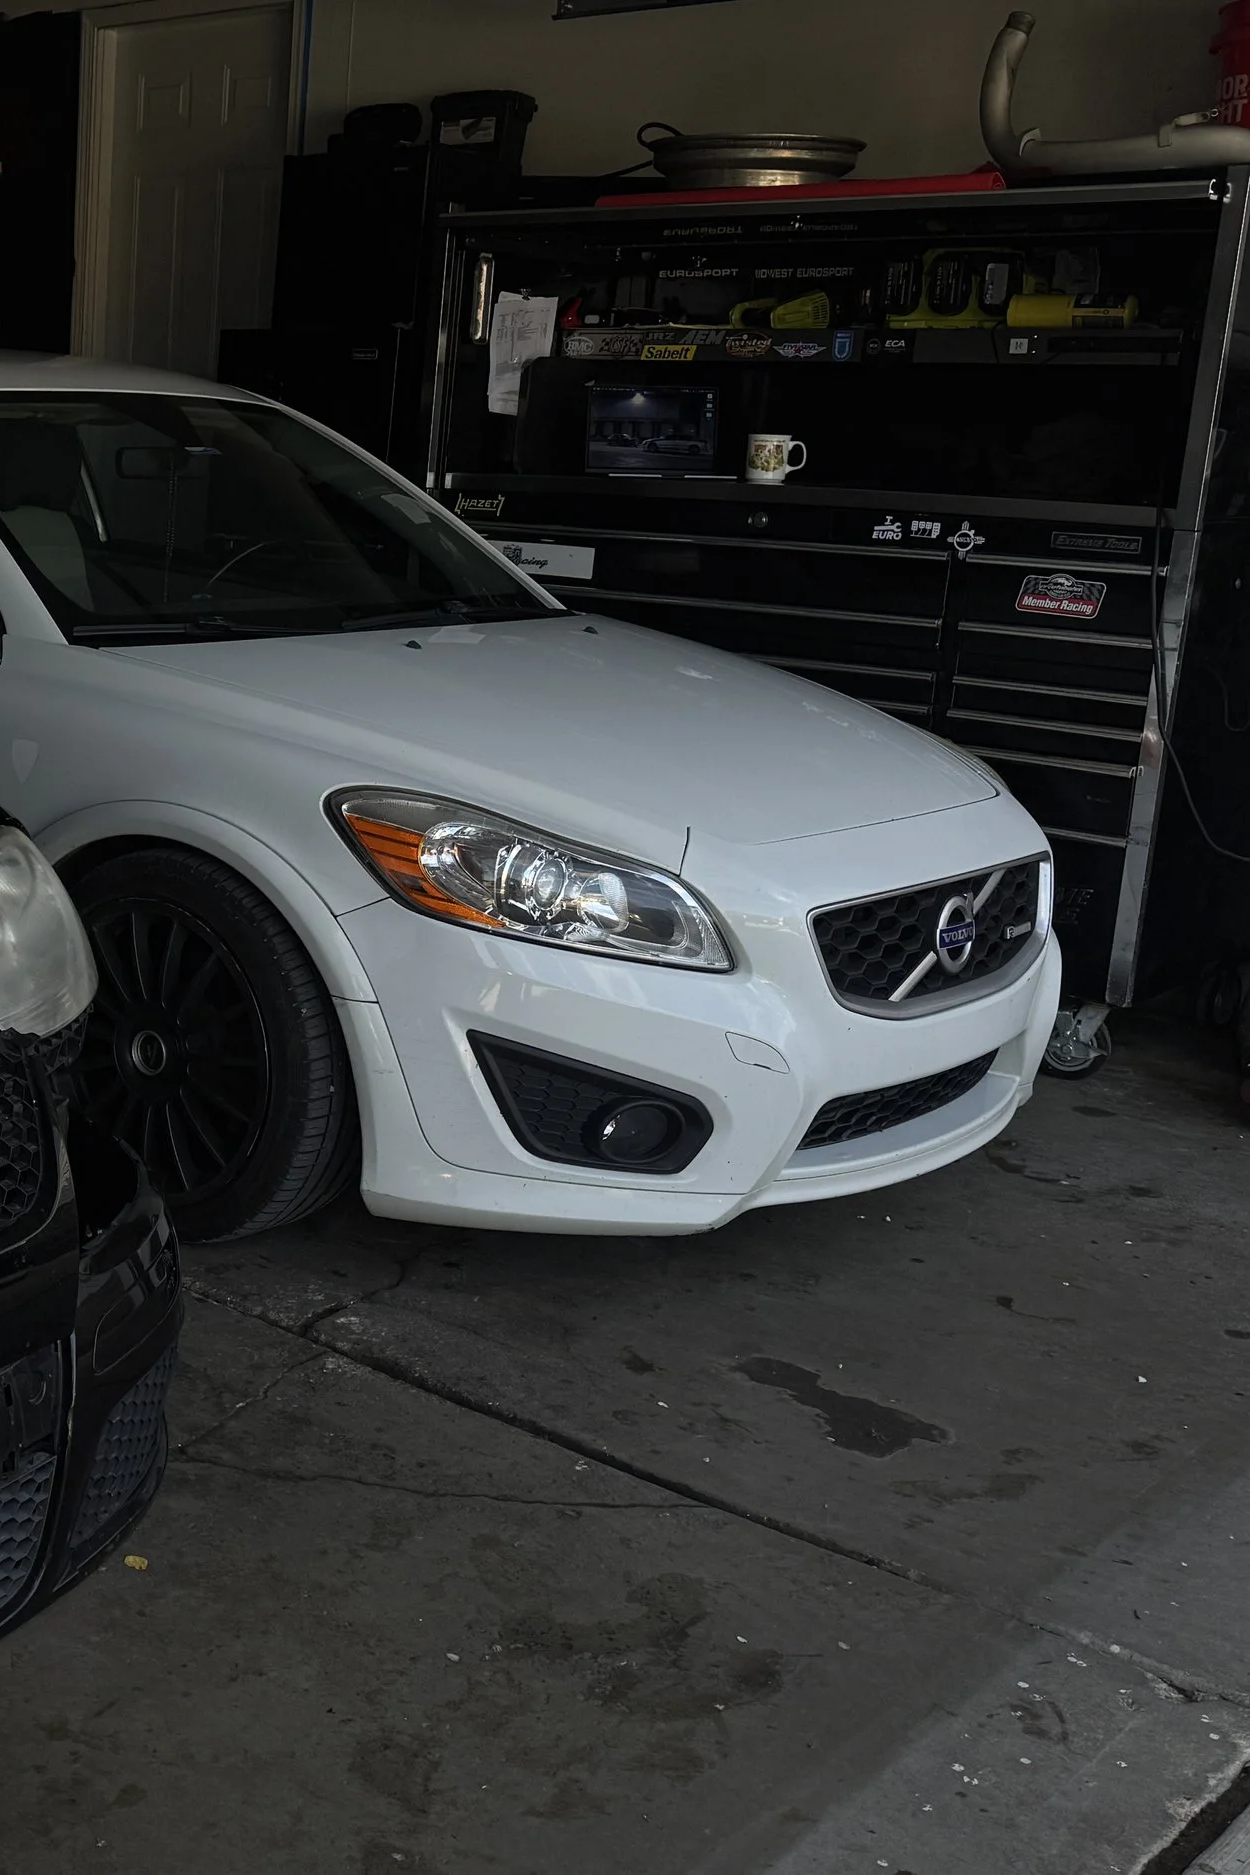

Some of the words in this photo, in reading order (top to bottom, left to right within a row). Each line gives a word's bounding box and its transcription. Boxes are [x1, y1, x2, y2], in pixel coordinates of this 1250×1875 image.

[658, 267, 740, 278] EUROSPORT
[796, 266, 855, 278] EUROSPORT
[678, 330, 727, 345] AEM
[884, 339, 906, 348] ECA
[645, 345, 691, 360] Sabelt
[871, 530, 903, 541] EURO
[1021, 595, 1061, 610] Member
[1060, 600, 1094, 615] Racing
[941, 925, 974, 944] VOLVO
